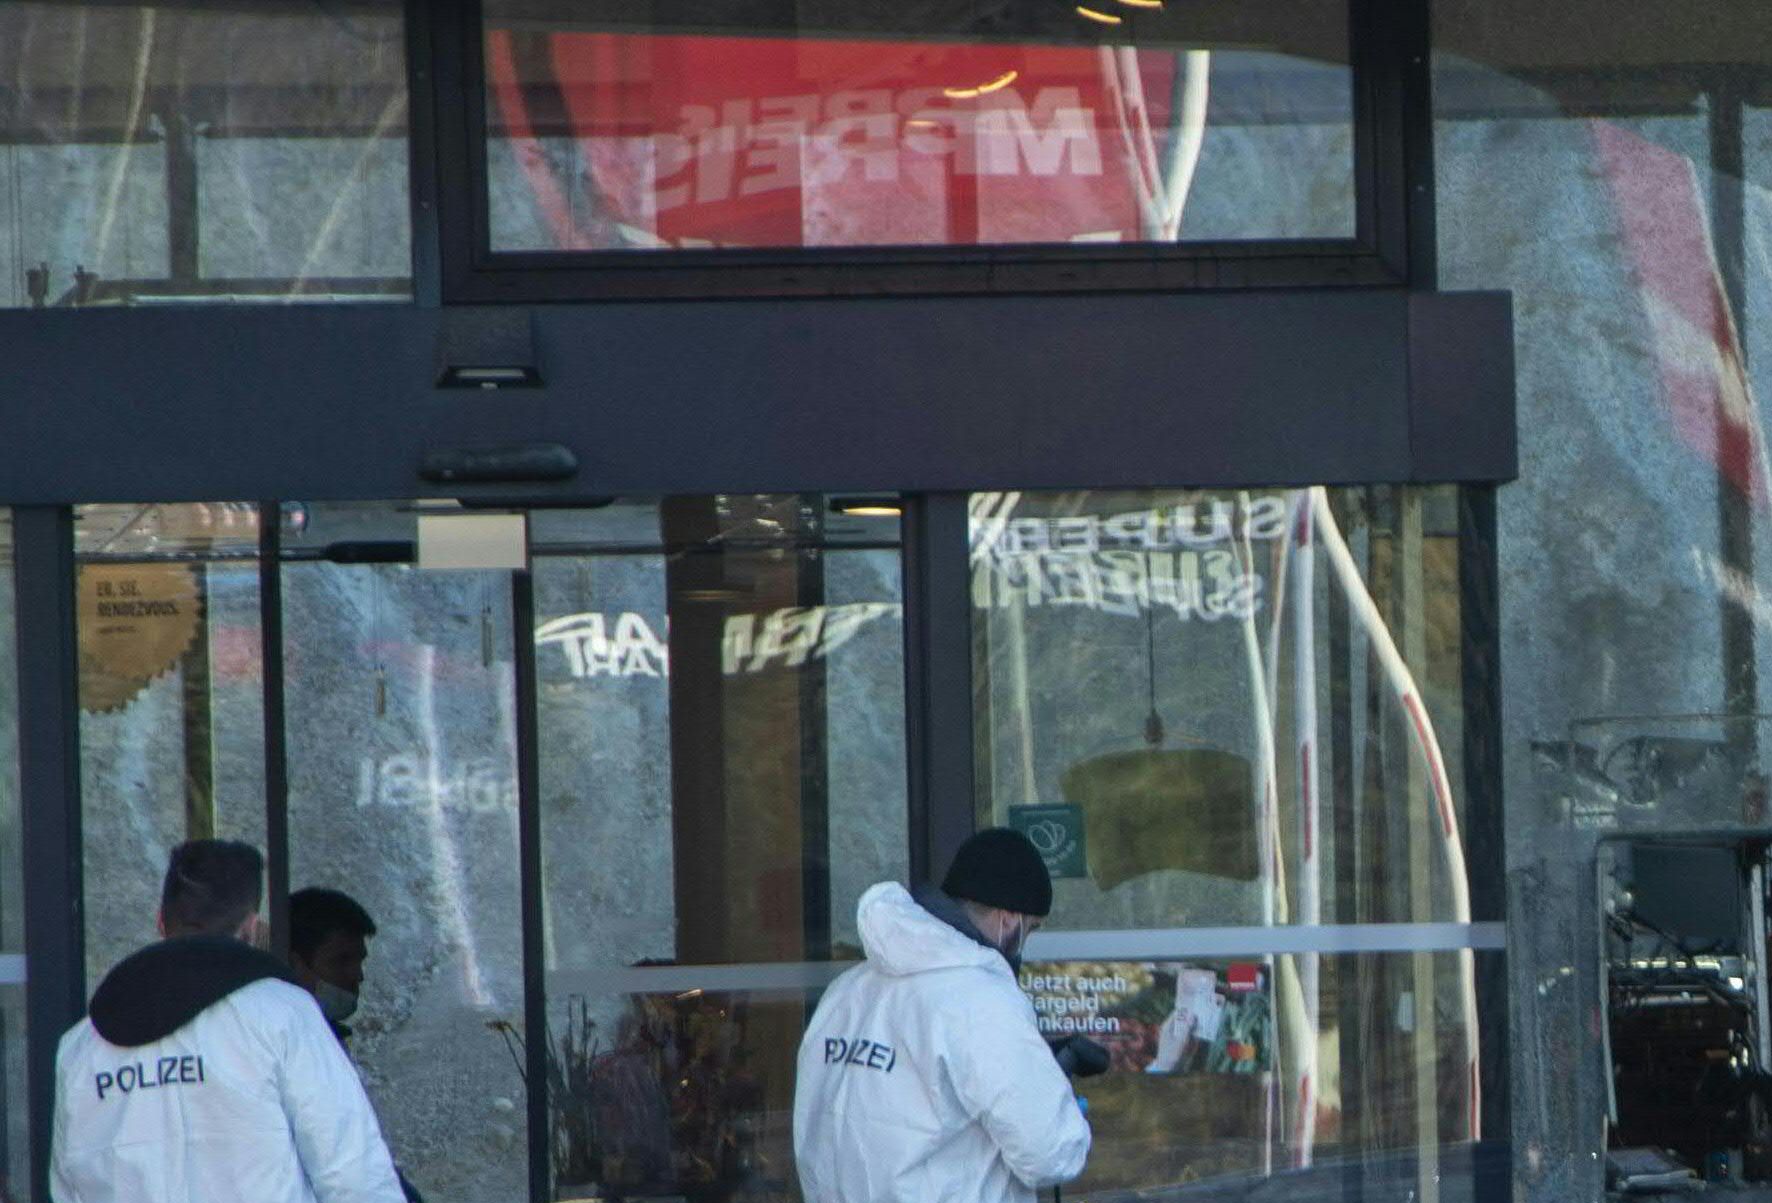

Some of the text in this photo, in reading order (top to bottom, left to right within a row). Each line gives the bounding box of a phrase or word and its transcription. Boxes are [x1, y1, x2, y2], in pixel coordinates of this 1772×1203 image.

[1019, 972, 1126, 991] Jetzt auch
[1038, 1012, 1120, 1032] nkaufen
[95, 1053, 204, 1100] POLIZEI
